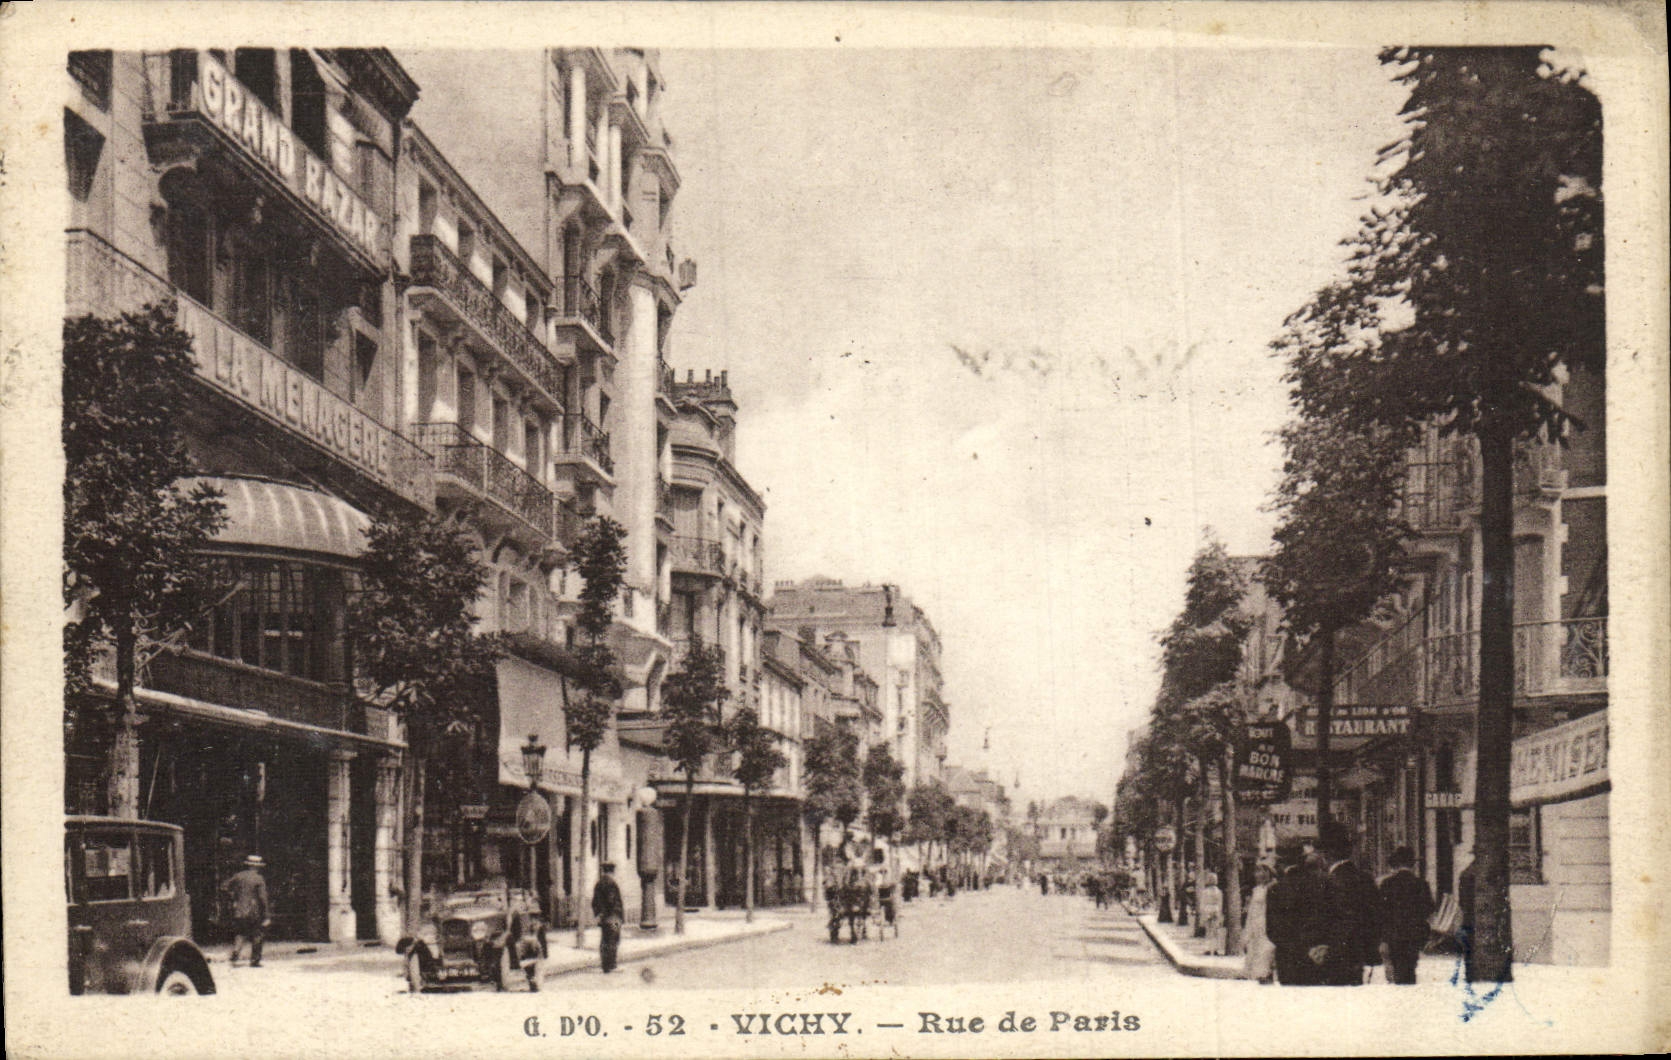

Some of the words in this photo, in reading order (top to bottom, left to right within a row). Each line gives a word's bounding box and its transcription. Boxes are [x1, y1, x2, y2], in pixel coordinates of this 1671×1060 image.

[202, 57, 297, 182] GRAND
[304, 152, 380, 262] BAZAR
[213, 324, 251, 399] LA
[260, 352, 389, 479] MENAGERE
[1248, 751, 1281, 769] BON
[1304, 719, 1411, 735] RTAURANT
